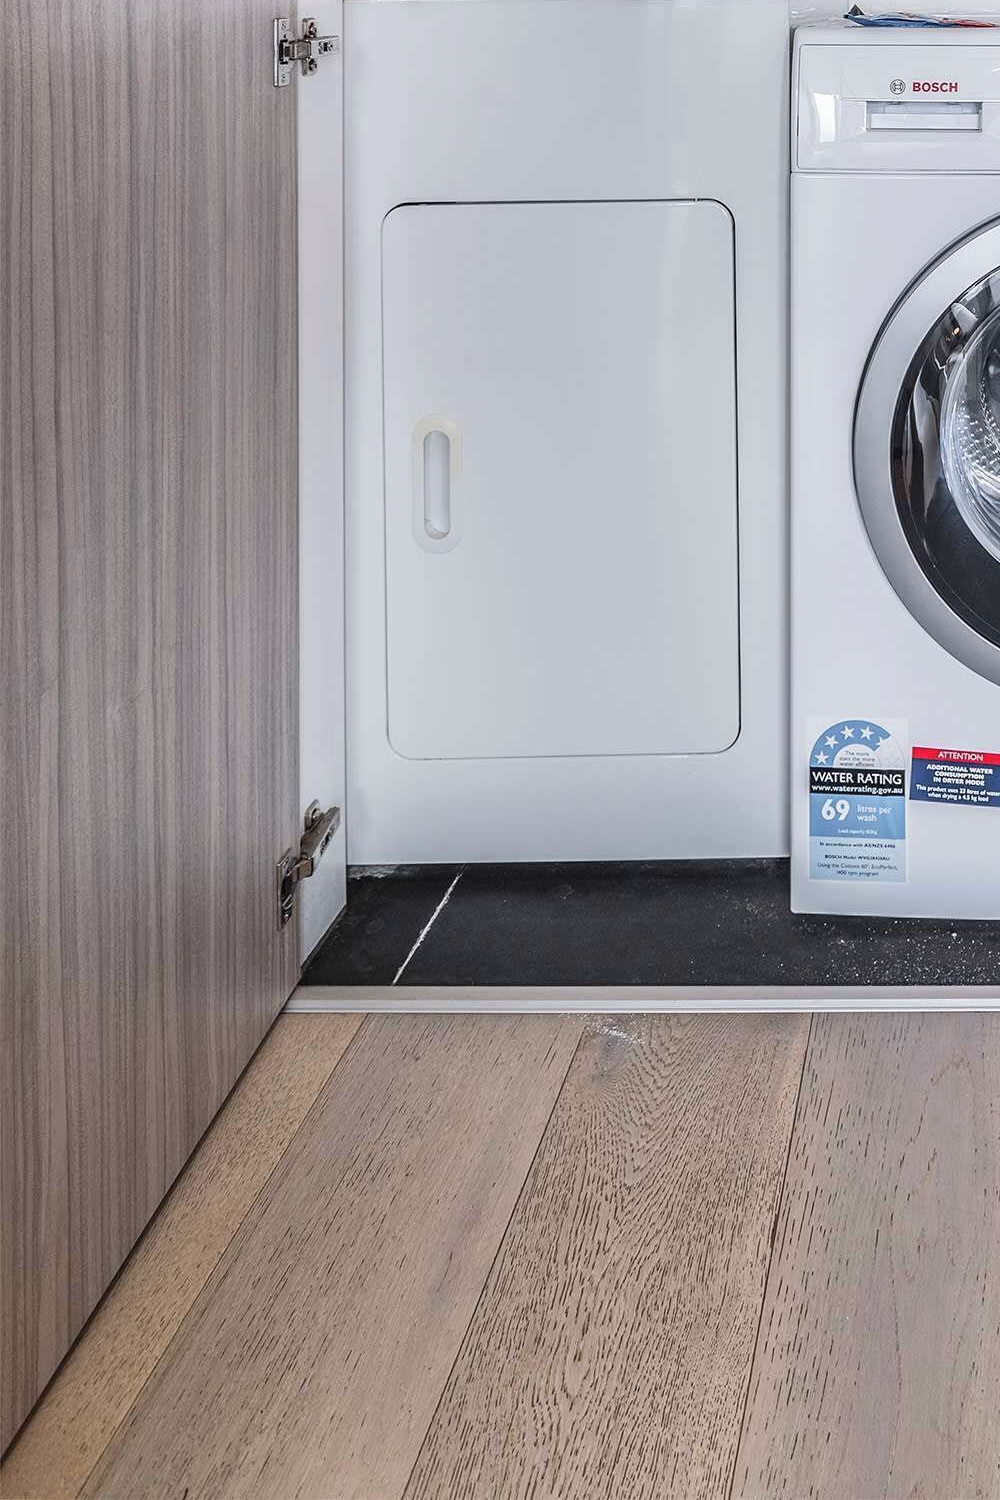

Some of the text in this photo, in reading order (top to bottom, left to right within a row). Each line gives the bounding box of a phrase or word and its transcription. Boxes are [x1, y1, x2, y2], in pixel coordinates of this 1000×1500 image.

[912, 82, 958, 92] BOSCH
[938, 752, 984, 761] ATTENTION
[927, 764, 968, 772] ADDITIONAL
[812, 772, 902, 784] WATER RATING
[935, 771, 984, 780] CONSUMPTION
[812, 785, 903, 794] www.waterrating.gov.au
[928, 786, 946, 794] product
[942, 793, 957, 801] drying
[821, 798, 892, 820] 69 litres per
